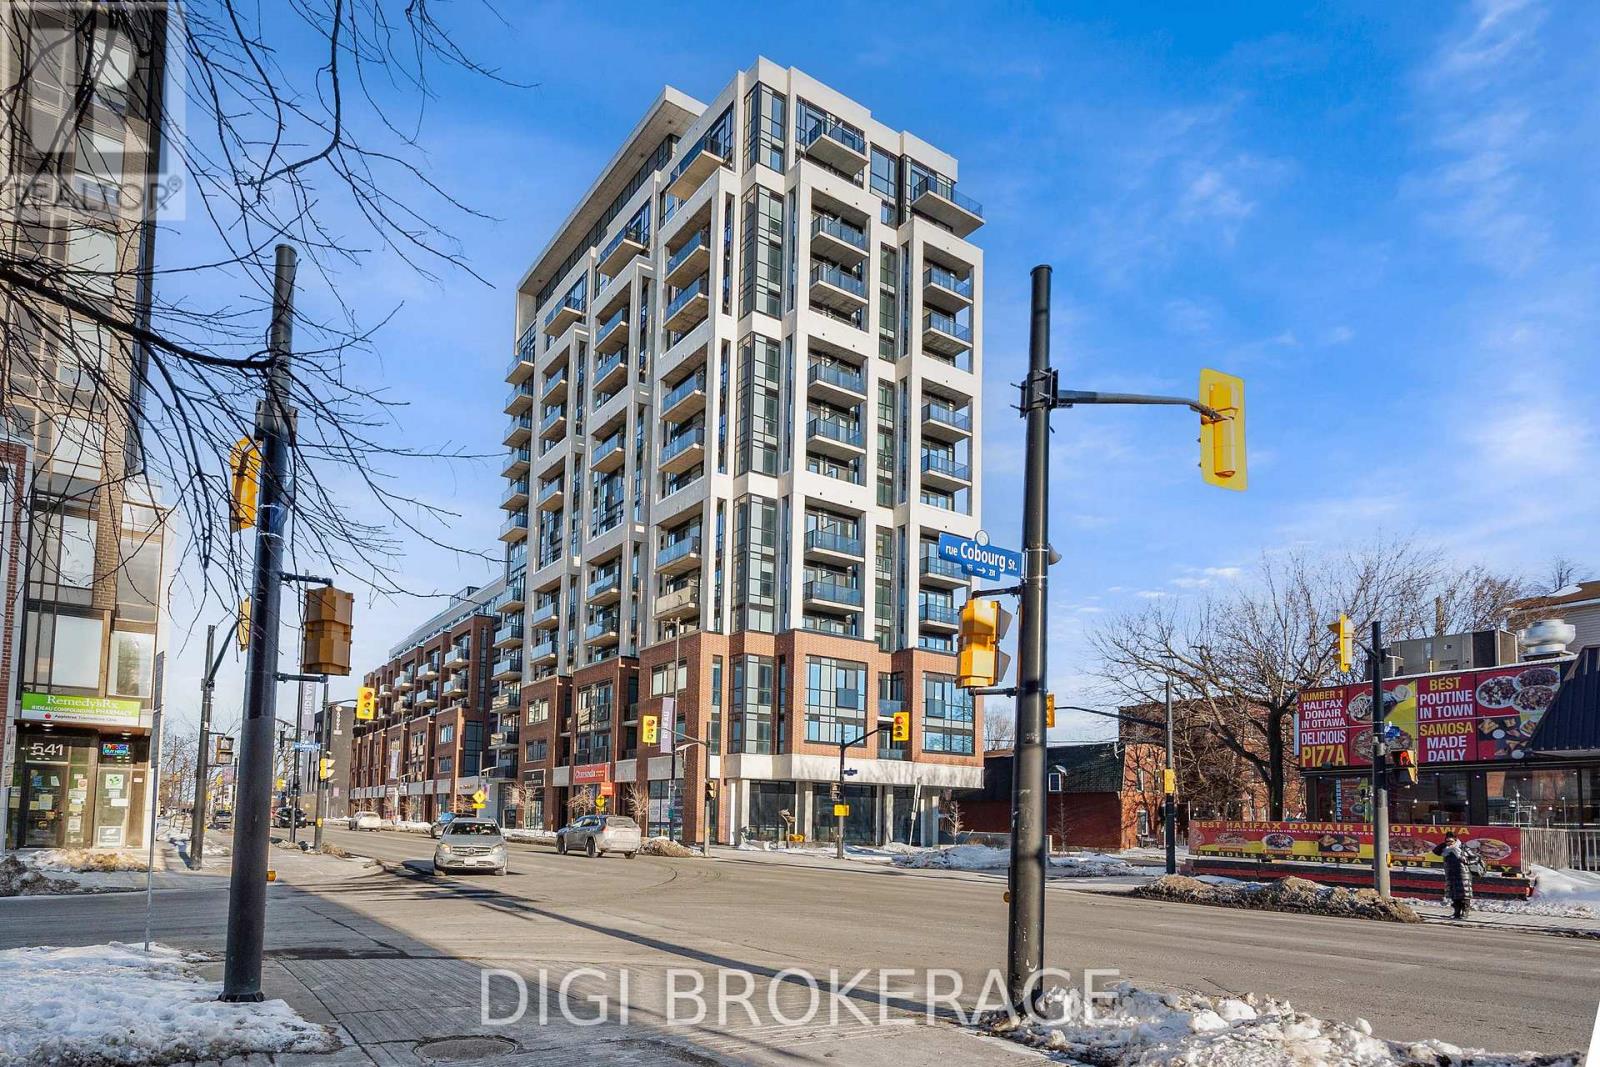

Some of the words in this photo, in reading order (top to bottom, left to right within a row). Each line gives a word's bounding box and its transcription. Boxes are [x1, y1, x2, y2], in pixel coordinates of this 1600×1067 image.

[945, 545, 958, 556] rue
[960, 542, 1006, 572] Cobourg
[1429, 677, 1461, 691] BEST
[1301, 690, 1336, 702] NUMBER
[1337, 689, 1343, 698] 1
[1420, 690, 1473, 705] POUTINE
[1303, 699, 1343, 711] HALIFAX
[1420, 707, 1432, 719] IN
[1435, 704, 1473, 718] TOWN
[1305, 709, 1341, 719] DONAIR
[1301, 720, 1310, 729] IN
[1312, 717, 1346, 728] OTTAWA
[1420, 722, 1473, 737] SAMOSA
[1301, 730, 1346, 745] DELICIOUS
[1427, 736, 1467, 749] MADE
[32, 742, 64, 756] 541
[1302, 744, 1346, 768] PIZZA
[1428, 749, 1466, 762] DAILY
[1195, 821, 1221, 829] BEST
[1226, 822, 1281, 830] HALIFAX
[1289, 823, 1354, 832] DONAIR
[1390, 825, 1470, 835] OTTAWA
[1286, 854, 1362, 864] SAMOSA
[1393, 860, 1432, 868] ADE
